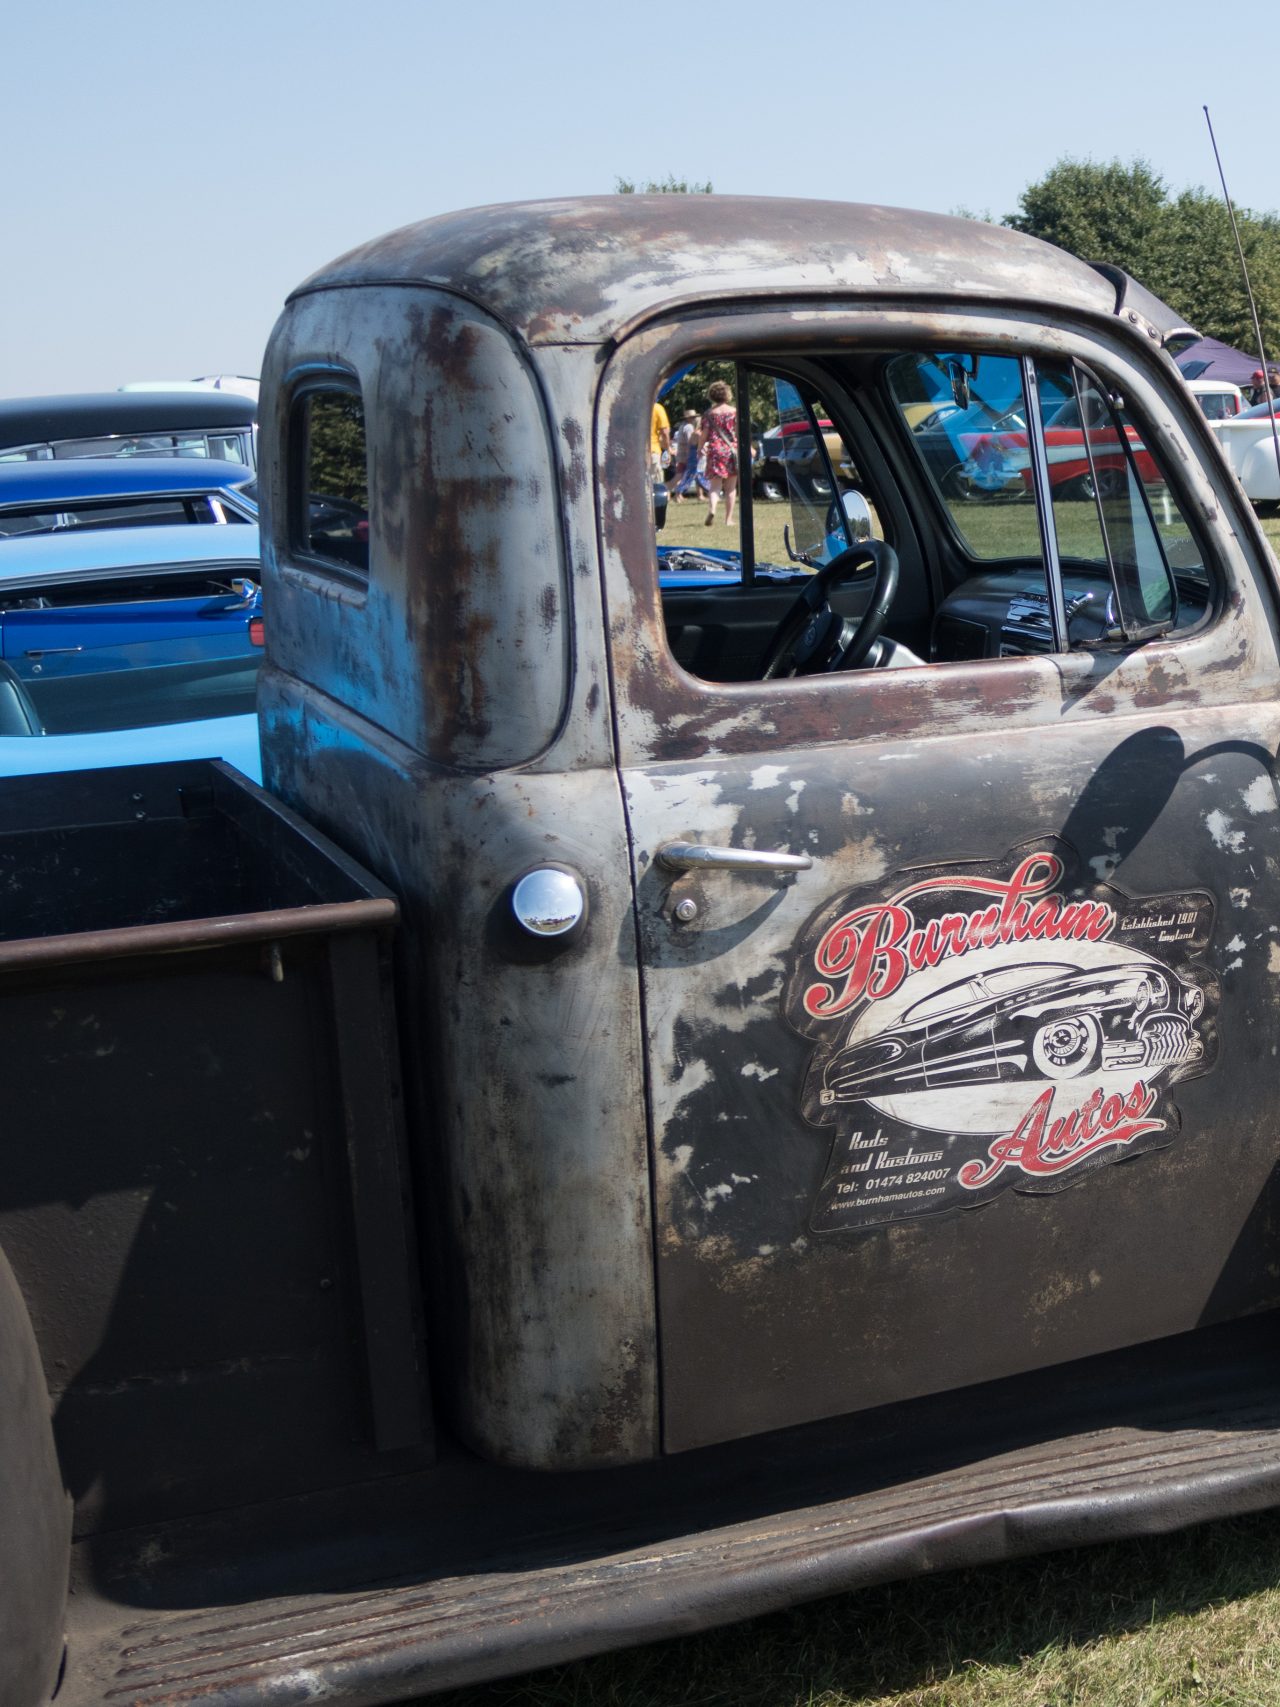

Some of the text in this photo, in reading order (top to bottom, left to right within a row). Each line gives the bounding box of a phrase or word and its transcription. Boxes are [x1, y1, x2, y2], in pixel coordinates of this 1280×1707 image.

[1121, 914, 1175, 931] Established
[1158, 927, 1195, 943] England
[804, 852, 1117, 1020] Burnham
[848, 1129, 888, 1151] Rods
[957, 1080, 1167, 1190] Autos
[840, 1148, 944, 1174] and Kustoms
[836, 1167, 951, 1195] Tel: 01474 824007
[831, 1186, 946, 1211] www.burnhamautos.com
